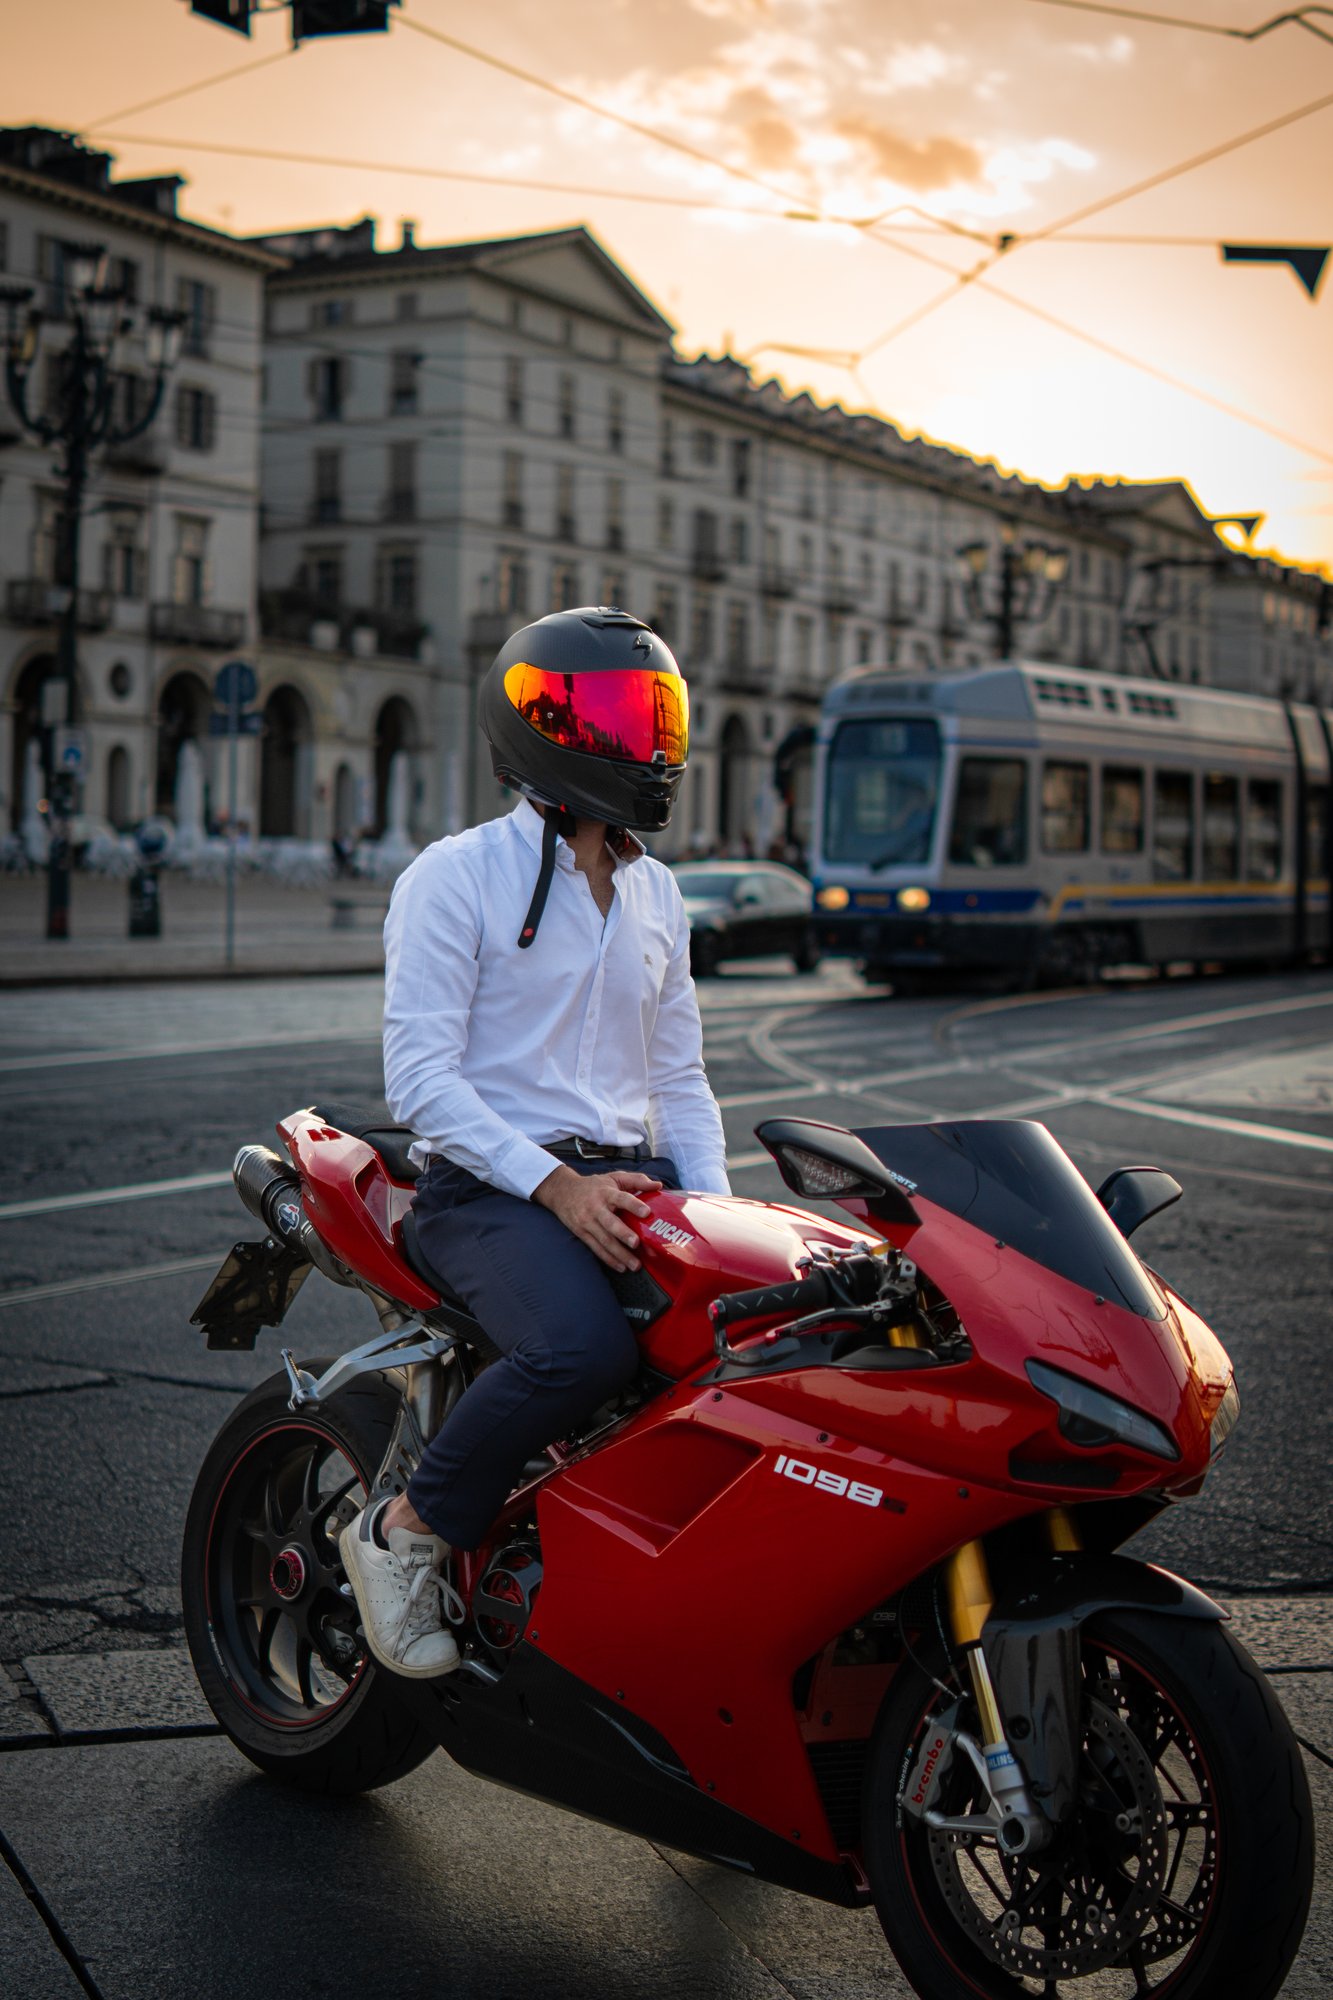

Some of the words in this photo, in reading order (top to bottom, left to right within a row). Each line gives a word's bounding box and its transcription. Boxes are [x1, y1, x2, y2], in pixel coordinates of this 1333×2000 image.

[649, 1218, 695, 1248] DUCATI
[773, 1454, 884, 1508] 1098
[912, 1738, 944, 1804] brembo
